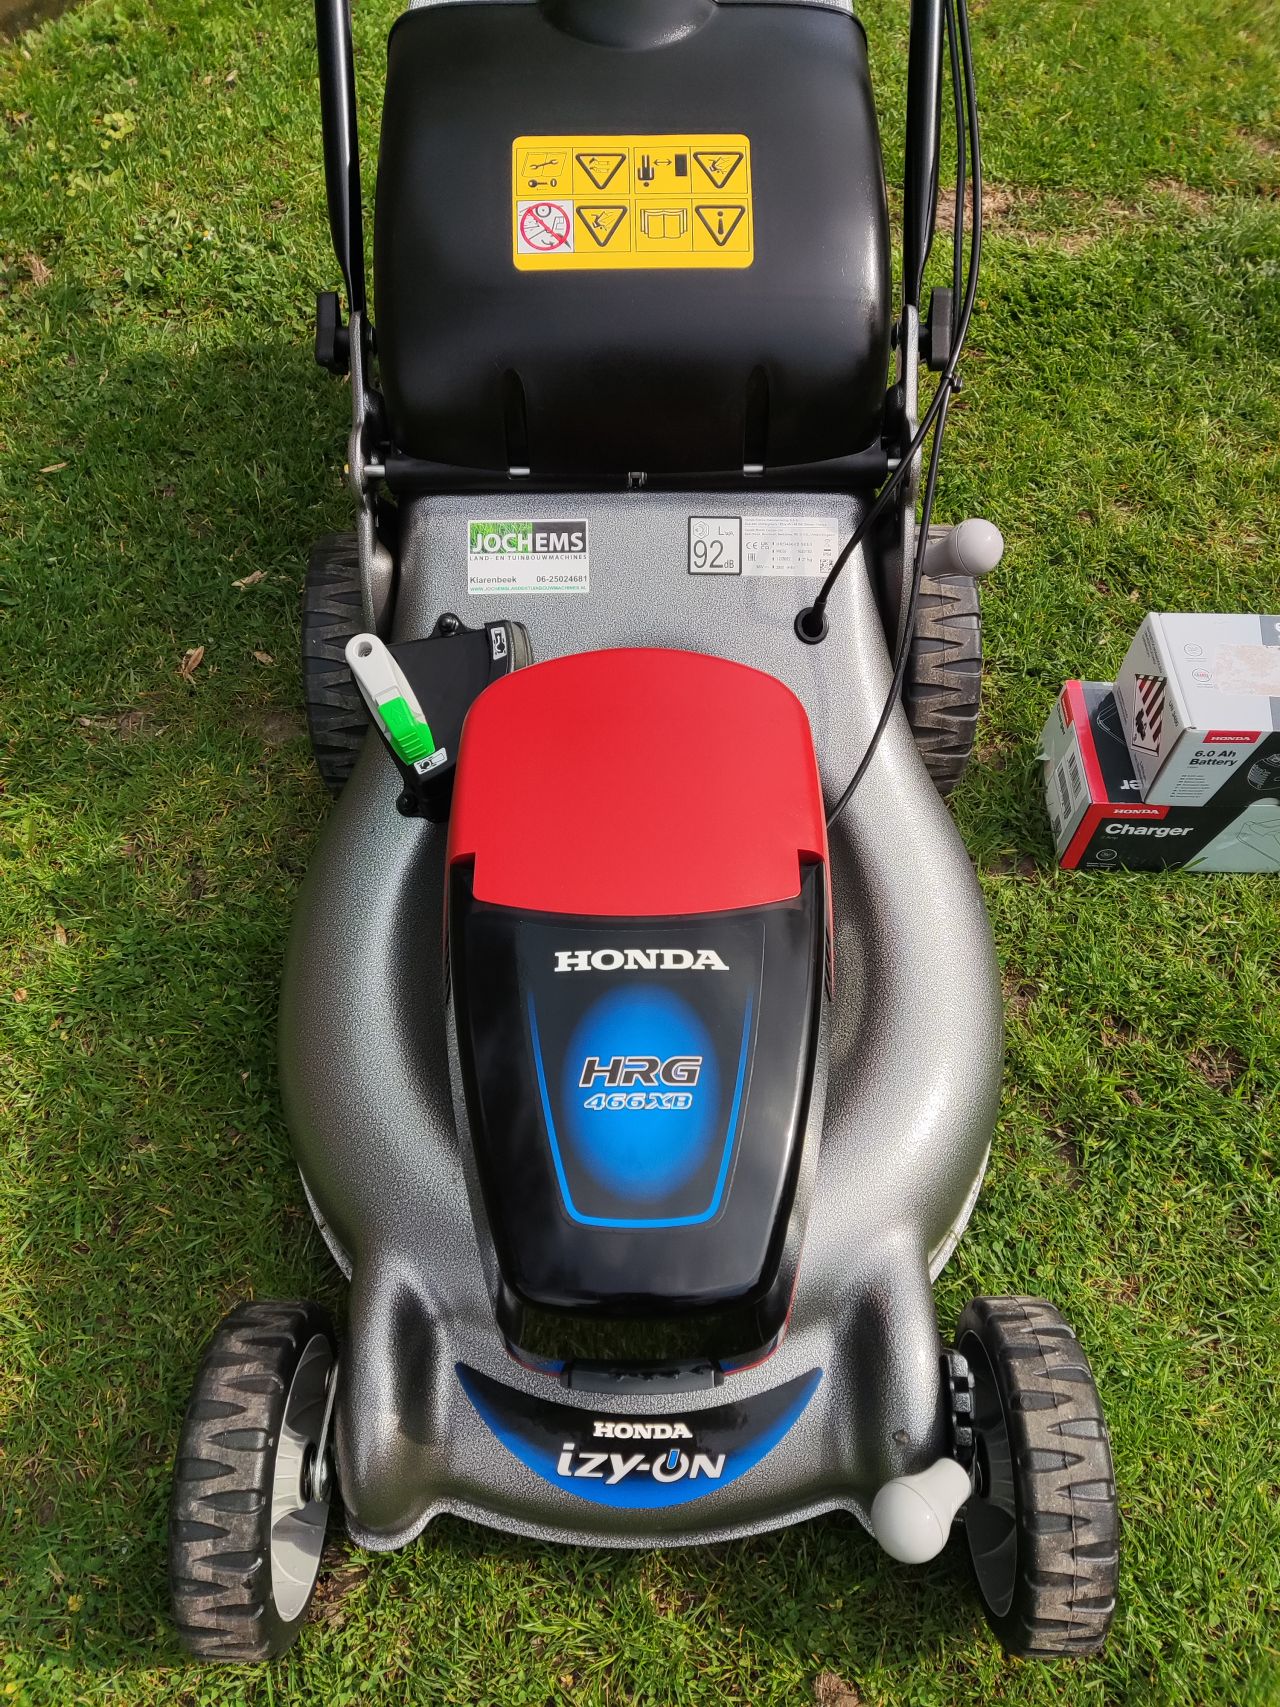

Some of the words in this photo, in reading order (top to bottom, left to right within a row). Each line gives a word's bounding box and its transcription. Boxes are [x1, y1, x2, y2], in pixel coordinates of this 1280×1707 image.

[473, 532, 583, 552] JOCHEMS
[693, 540, 724, 568] 92
[1189, 759, 1238, 767] Battery
[1105, 823, 1194, 838] Charger
[554, 949, 730, 972] HONDA
[578, 1056, 703, 1088] HRG
[583, 1092, 693, 1111] 466XB
[593, 1421, 693, 1440] HONDA
